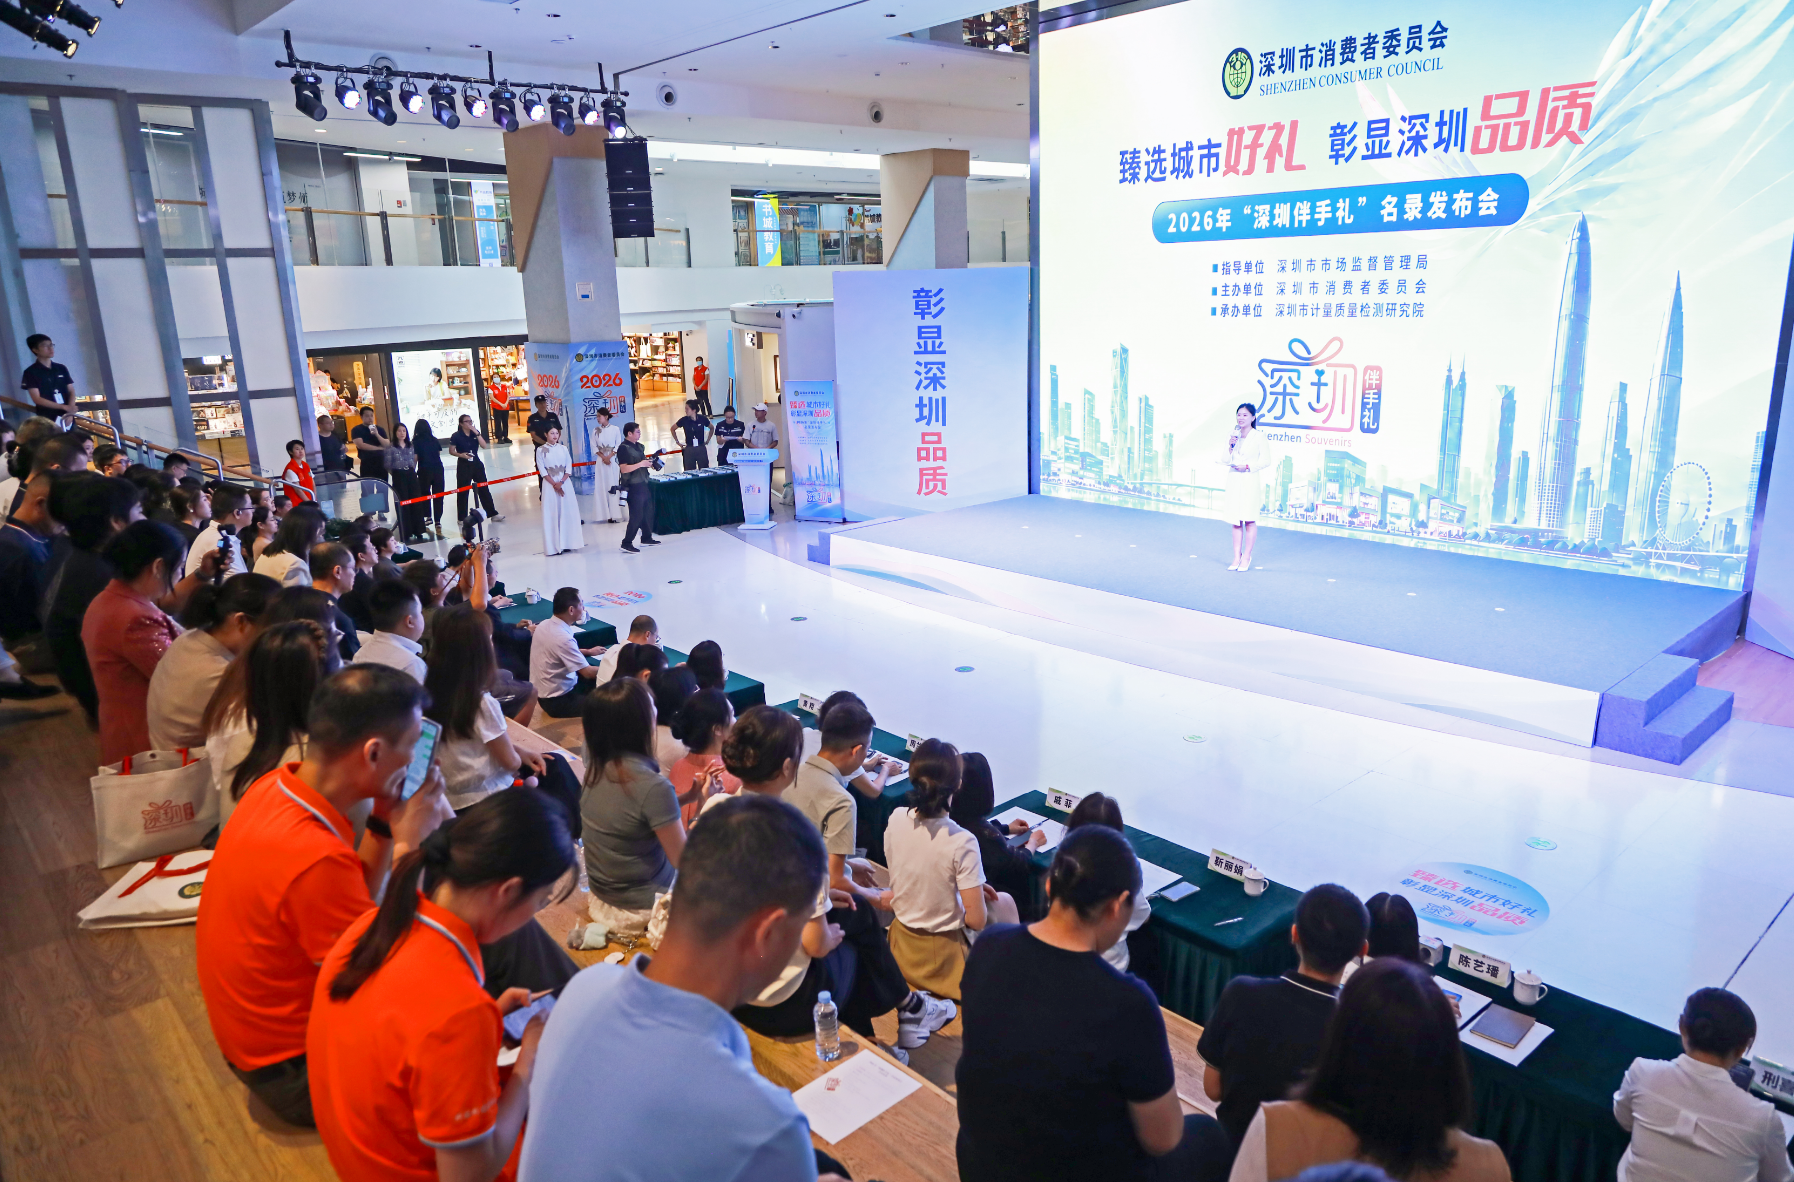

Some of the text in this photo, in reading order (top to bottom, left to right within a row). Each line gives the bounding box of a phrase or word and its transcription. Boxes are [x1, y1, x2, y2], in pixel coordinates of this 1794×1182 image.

[1258, 20, 1449, 78] 深圳市消费者委员会
[1259, 57, 1444, 96] SHENZHEN CONSUMER COUNCIL
[1118, 80, 1598, 185] 臻选城市好礼 彰显深圳品质
[1221, 254, 1428, 276] 指导单位 深圳市市场监督管理局
[1220, 278, 1427, 297] 主办单位 深圳市消费者委员会
[1220, 302, 1425, 318] 承办单位 深圳市计量质量检测研究院
[537, 374, 560, 389] 2026
[580, 373, 623, 389] 2026
[912, 287, 948, 497] 彰显深圳品质
[1362, 369, 1381, 430] 伴手礼
[1266, 431, 1352, 448] enzhen Souvenirs
[1214, 856, 1244, 877] 靳丽娟
